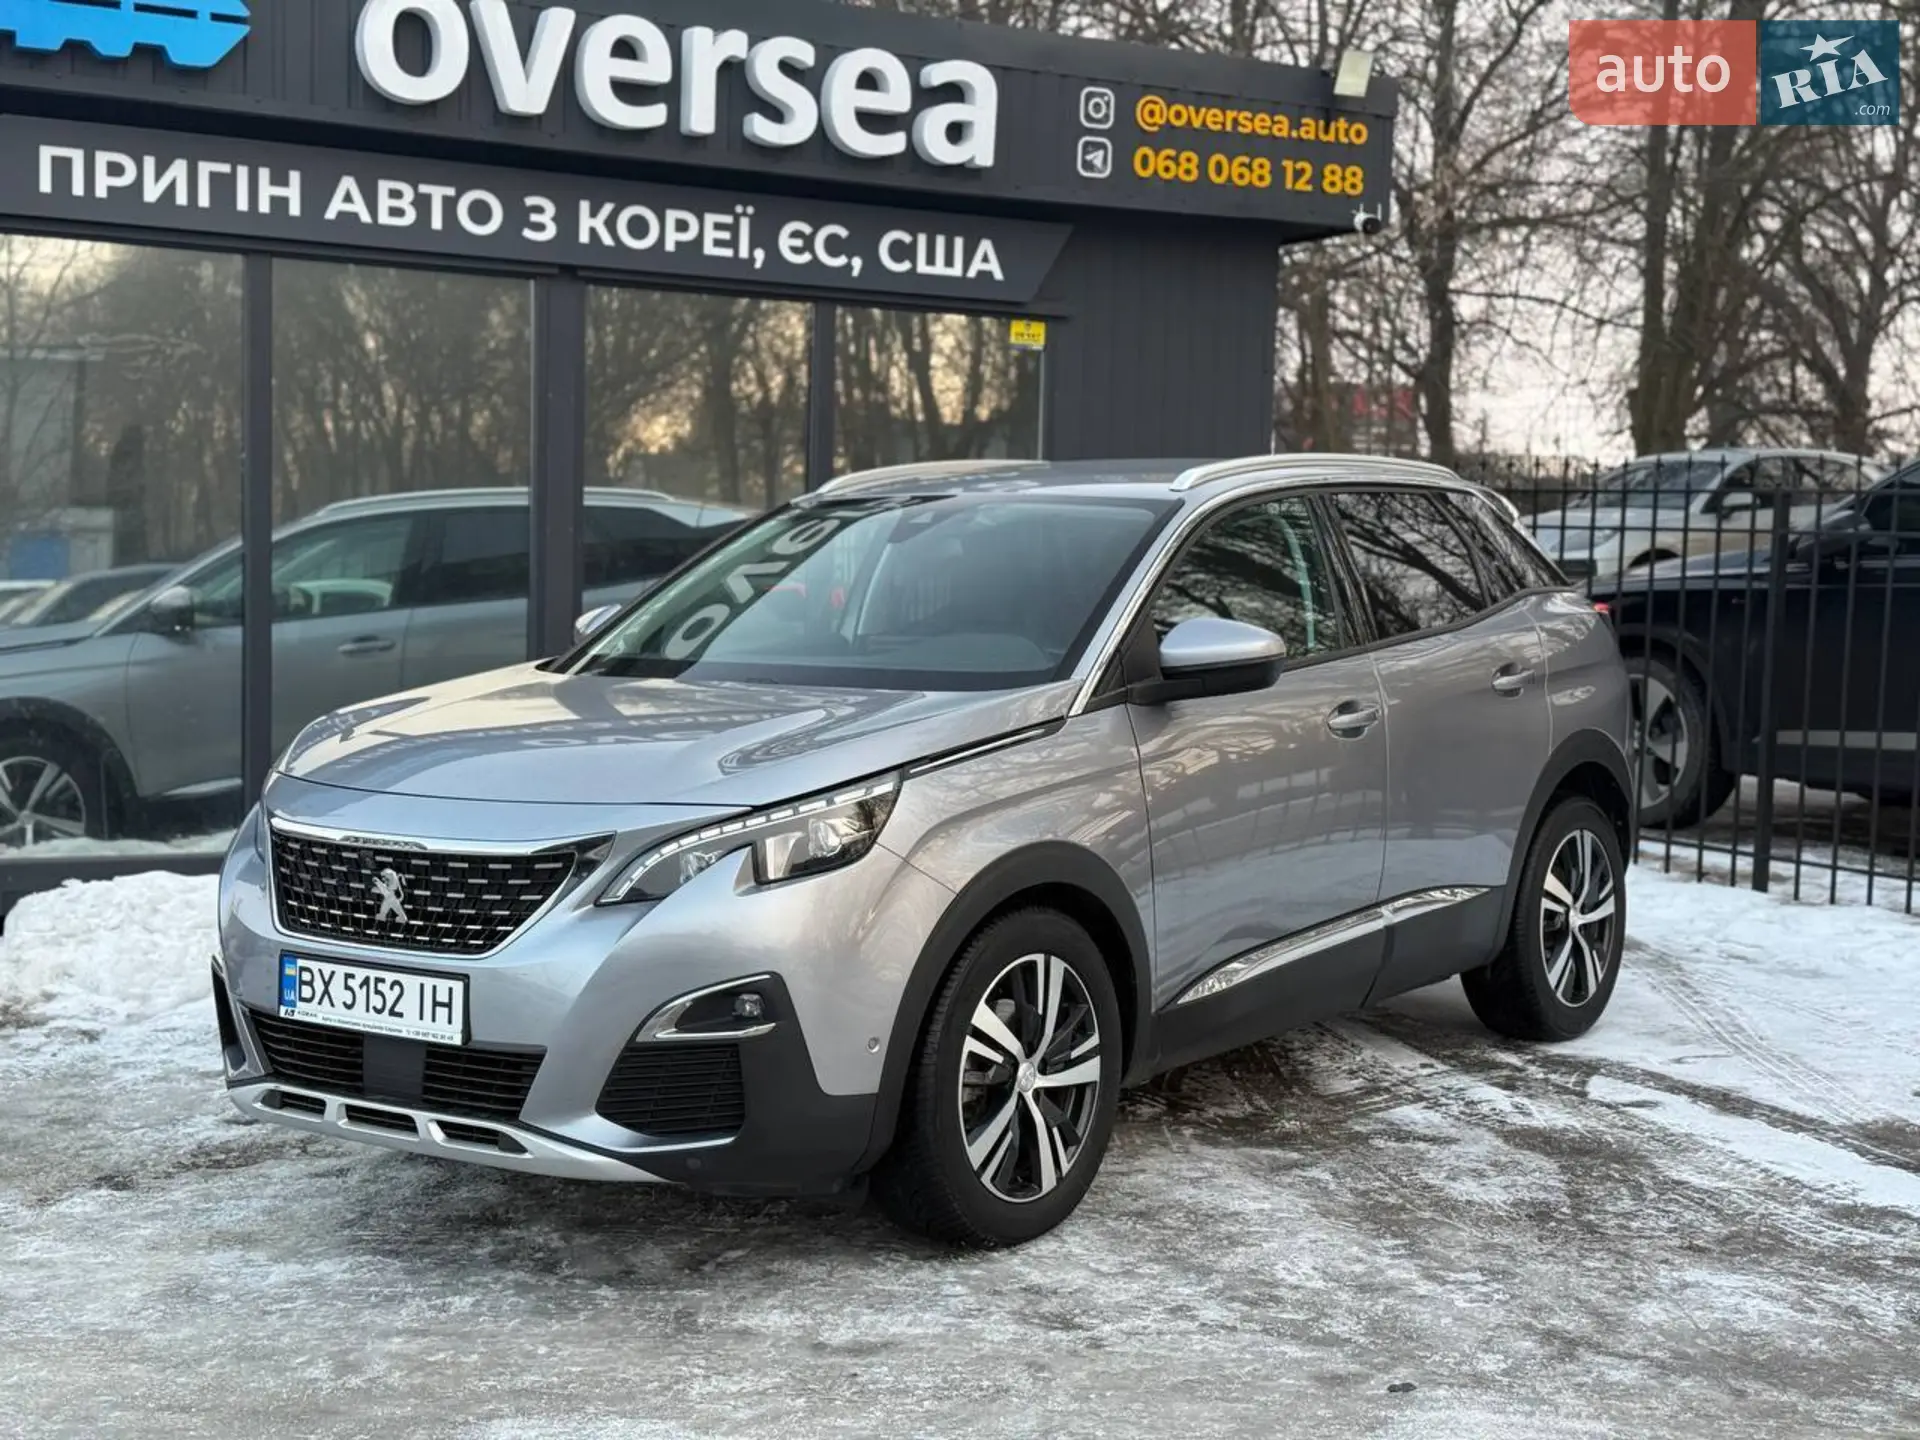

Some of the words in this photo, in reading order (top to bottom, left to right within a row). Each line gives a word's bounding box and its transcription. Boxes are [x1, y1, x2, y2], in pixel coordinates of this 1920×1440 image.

[355, 0, 998, 167] oversea
[1136, 95, 1368, 144] @oversea.auto
[1133, 146, 1199, 182] 068
[1208, 154, 1271, 188] 068
[1281, 159, 1313, 191] 12
[1322, 164, 1363, 195] 88
[38, 145, 301, 217] ПРИГІН
[324, 175, 502, 236] АВТО
[522, 196, 557, 241] З
[578, 200, 765, 269] КОРЕЇ,
[778, 221, 863, 278] ЄС,
[878, 231, 1004, 281] США
[284, 988, 295, 1001] UA
[298, 965, 336, 1008] BX
[342, 972, 405, 1019] 5152
[419, 982, 453, 1025] IH
